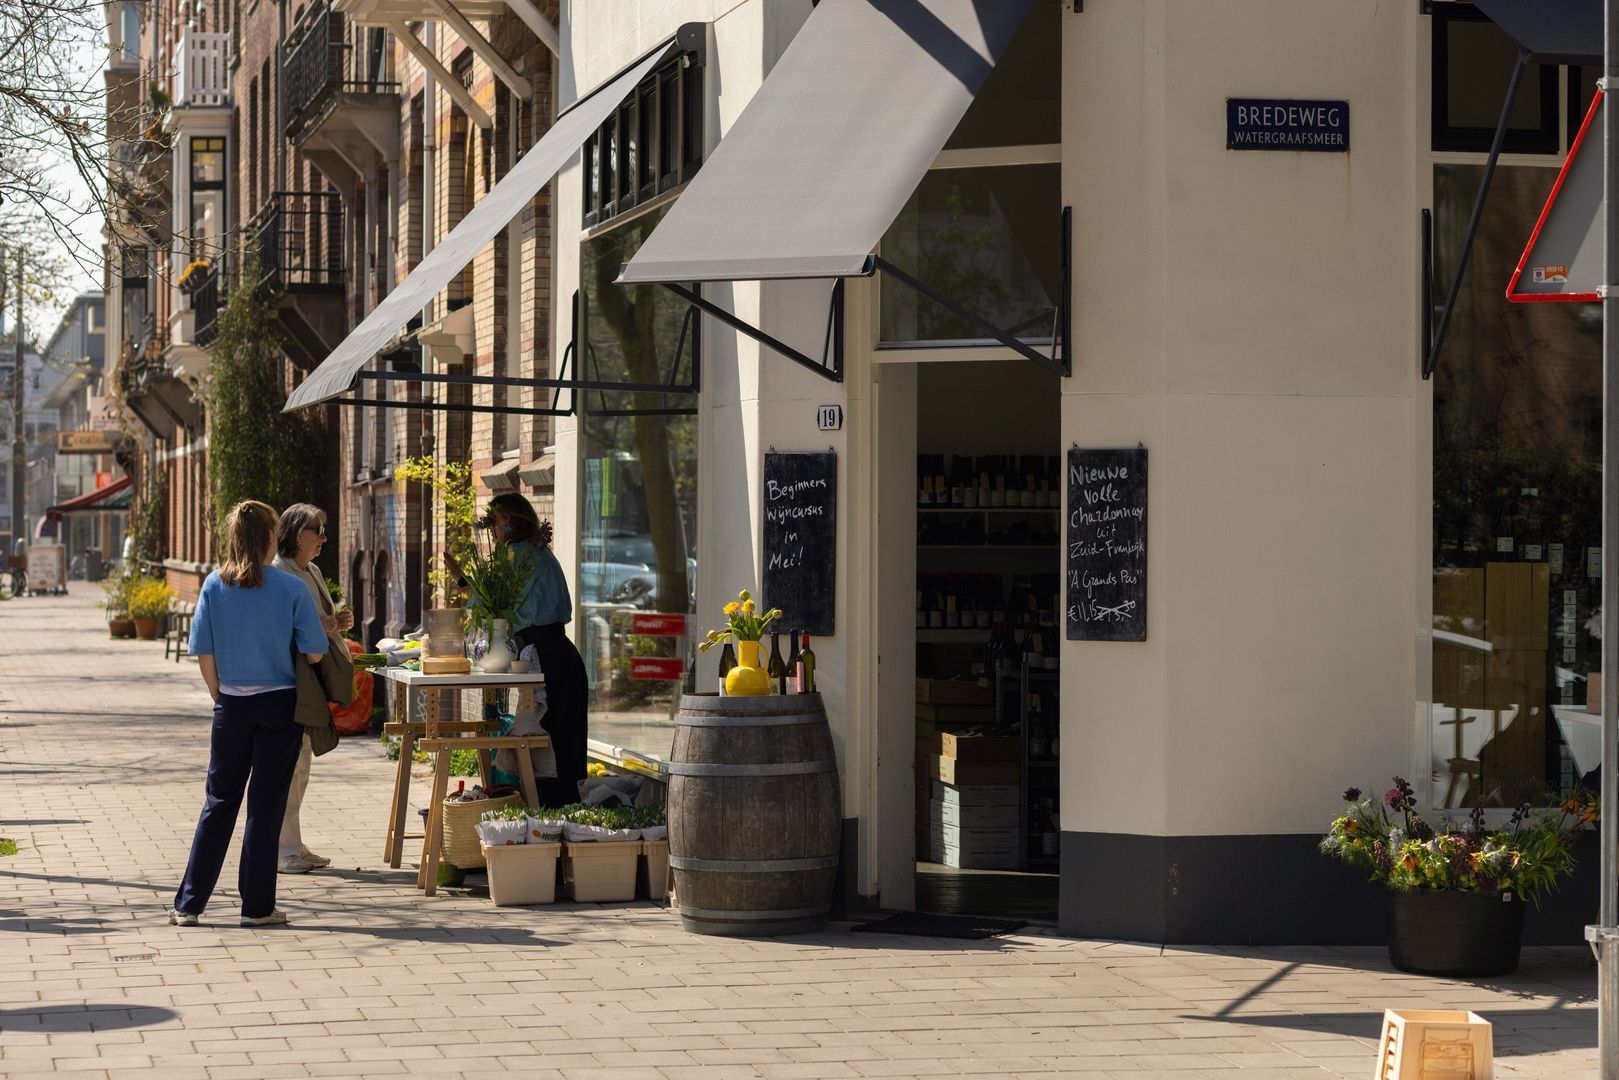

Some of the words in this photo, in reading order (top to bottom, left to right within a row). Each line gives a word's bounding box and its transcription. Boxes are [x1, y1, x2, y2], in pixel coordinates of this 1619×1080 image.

[1238, 106, 1340, 127] BREDEWEG
[1234, 131, 1344, 145] WATERGRAAFSMEER
[823, 409, 835, 427] 19
[1070, 465, 1129, 485] Nieuwe
[767, 479, 827, 500] Beginners
[1070, 505, 1144, 529] Chardonnay
[784, 531, 798, 544] in
[1096, 523, 1117, 539] uit
[768, 545, 804, 570] Mei!
